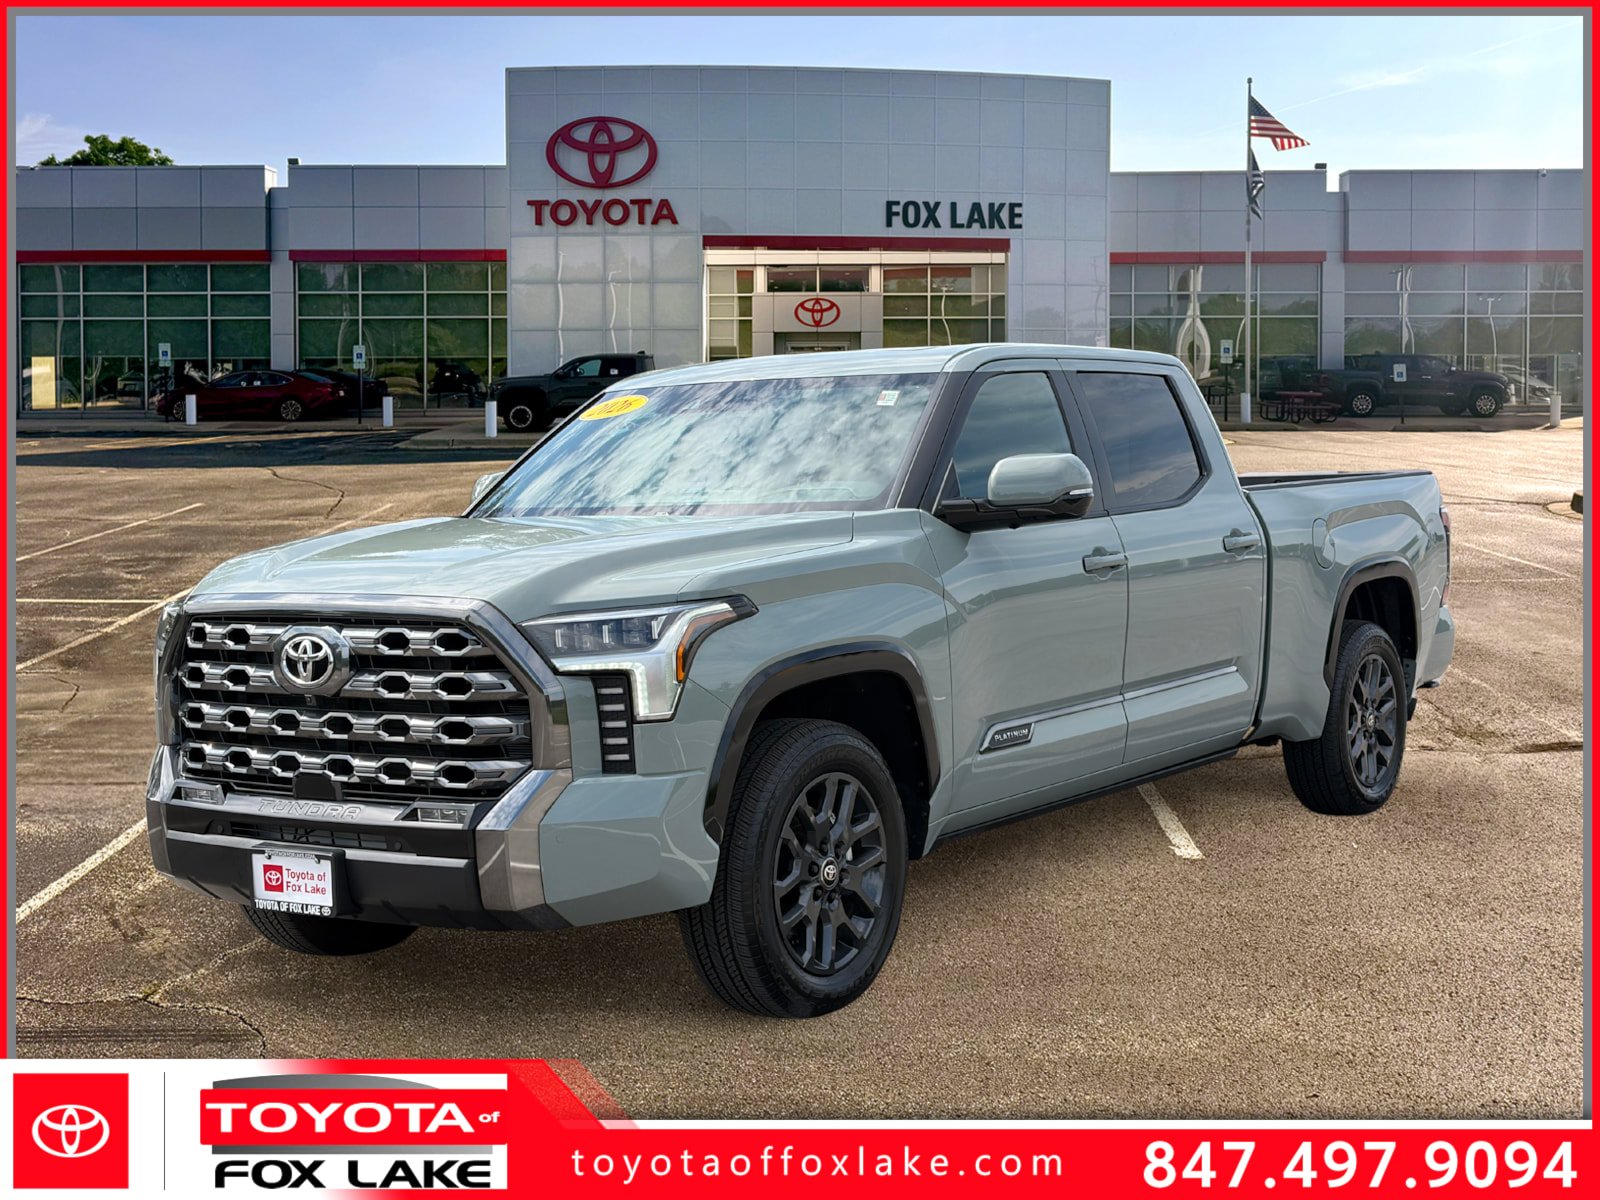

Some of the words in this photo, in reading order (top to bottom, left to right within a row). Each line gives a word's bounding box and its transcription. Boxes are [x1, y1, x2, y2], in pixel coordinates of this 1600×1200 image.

[527, 199, 679, 227] TOYOTA
[885, 200, 942, 229] FOX
[949, 201, 1023, 230] LAKE
[994, 729, 1029, 741] PLATINUM
[258, 799, 362, 820] TUNDRA
[285, 868, 315, 881] Toyota
[317, 872, 326, 882] of
[285, 881, 302, 893] Fox
[304, 883, 327, 895] Lake
[254, 899, 279, 911] TOYOTA
[280, 901, 288, 912] OF
[289, 902, 303, 913] FOX
[303, 904, 321, 915] LAKE
